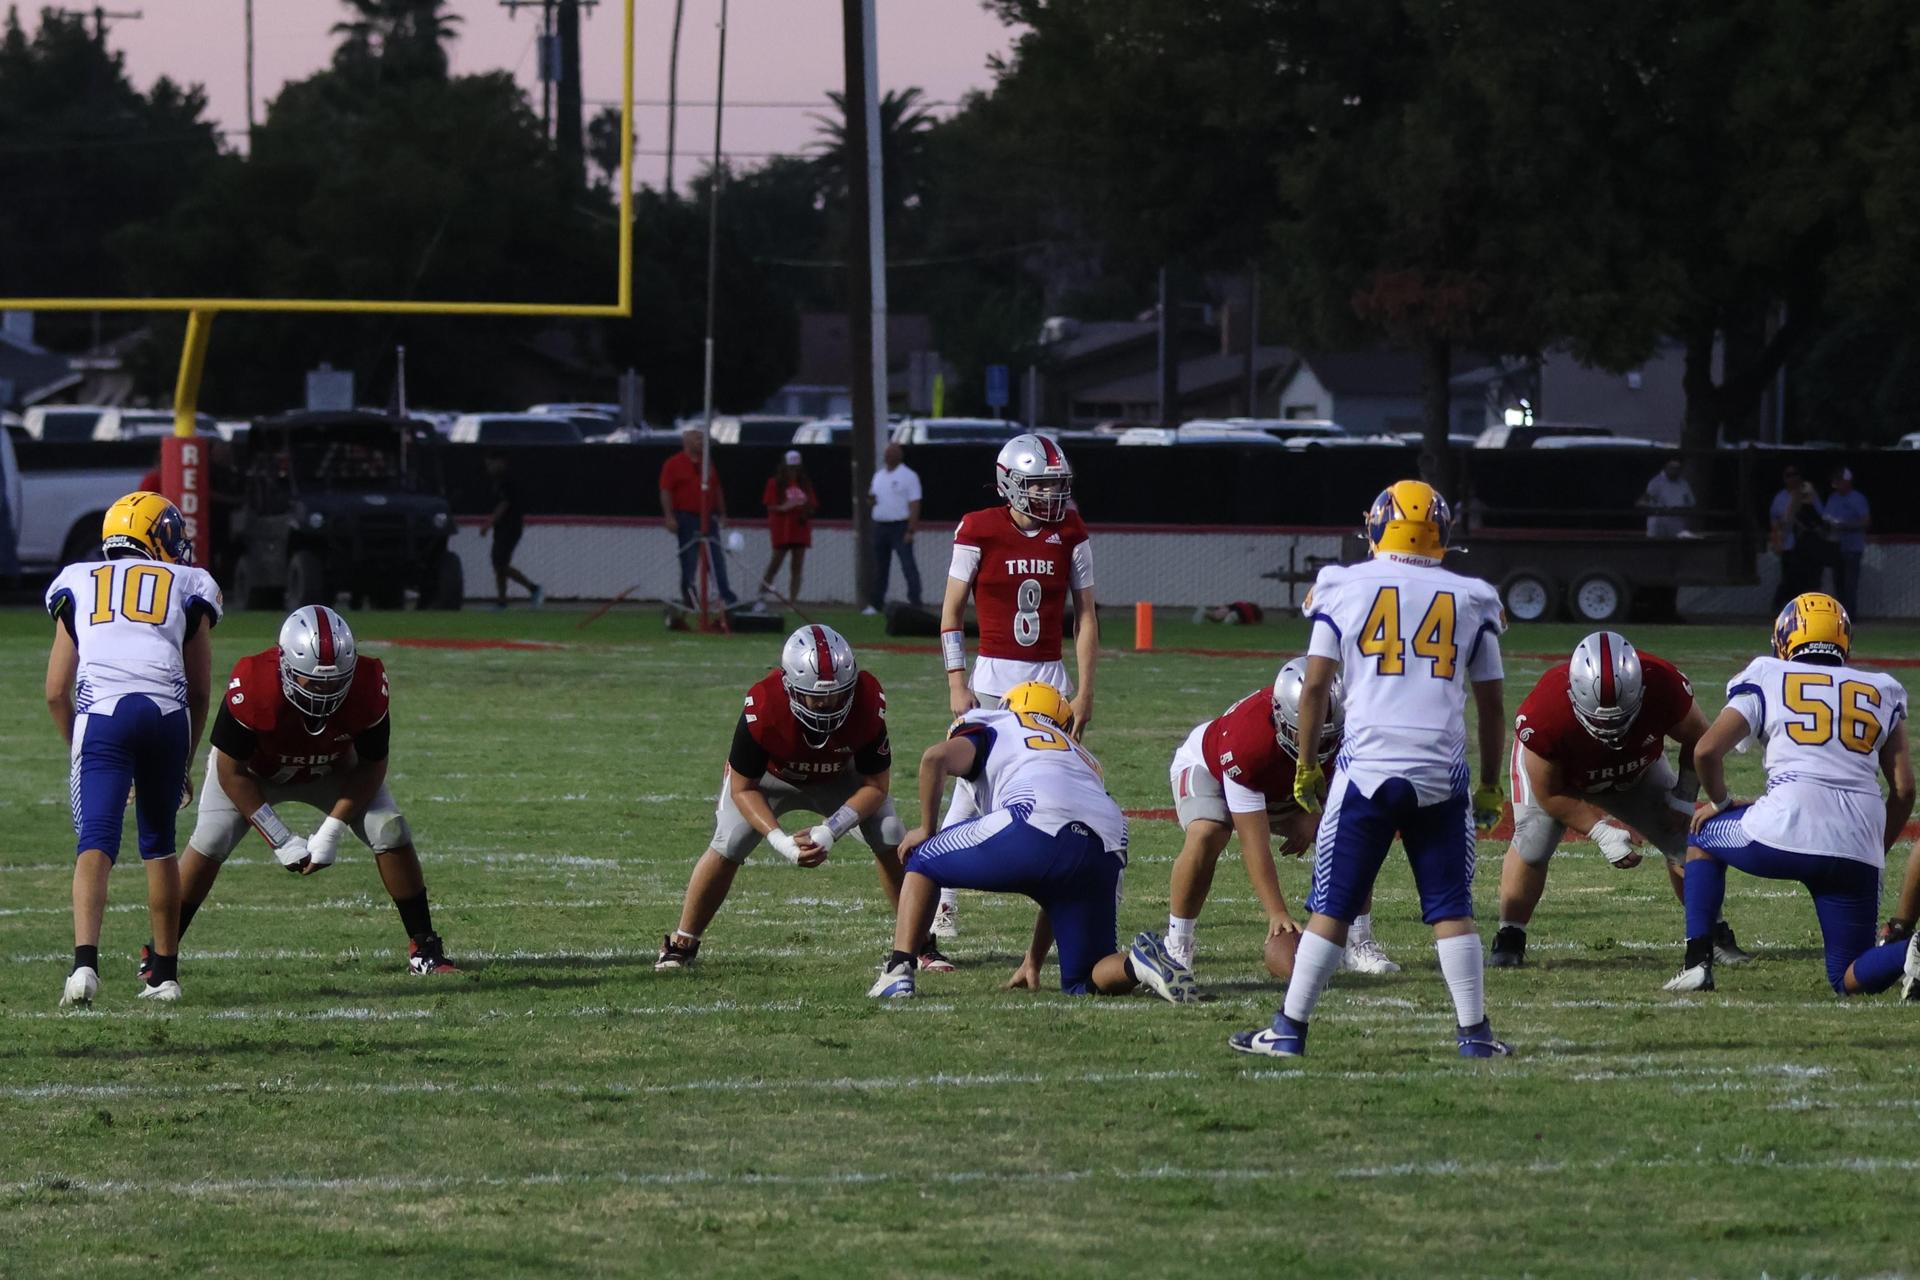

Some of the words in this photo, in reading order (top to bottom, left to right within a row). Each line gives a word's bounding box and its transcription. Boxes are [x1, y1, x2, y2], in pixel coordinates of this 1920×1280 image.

[1005, 559, 1055, 575] TRIBE
[89, 564, 175, 626] 10
[1013, 579, 1042, 647] 8
[1357, 586, 1458, 681] 44
[1782, 672, 1883, 756] 56
[279, 752, 341, 765] TRIBE
[788, 761, 842, 774] TRIBE
[1586, 755, 1649, 781] TRIBE
